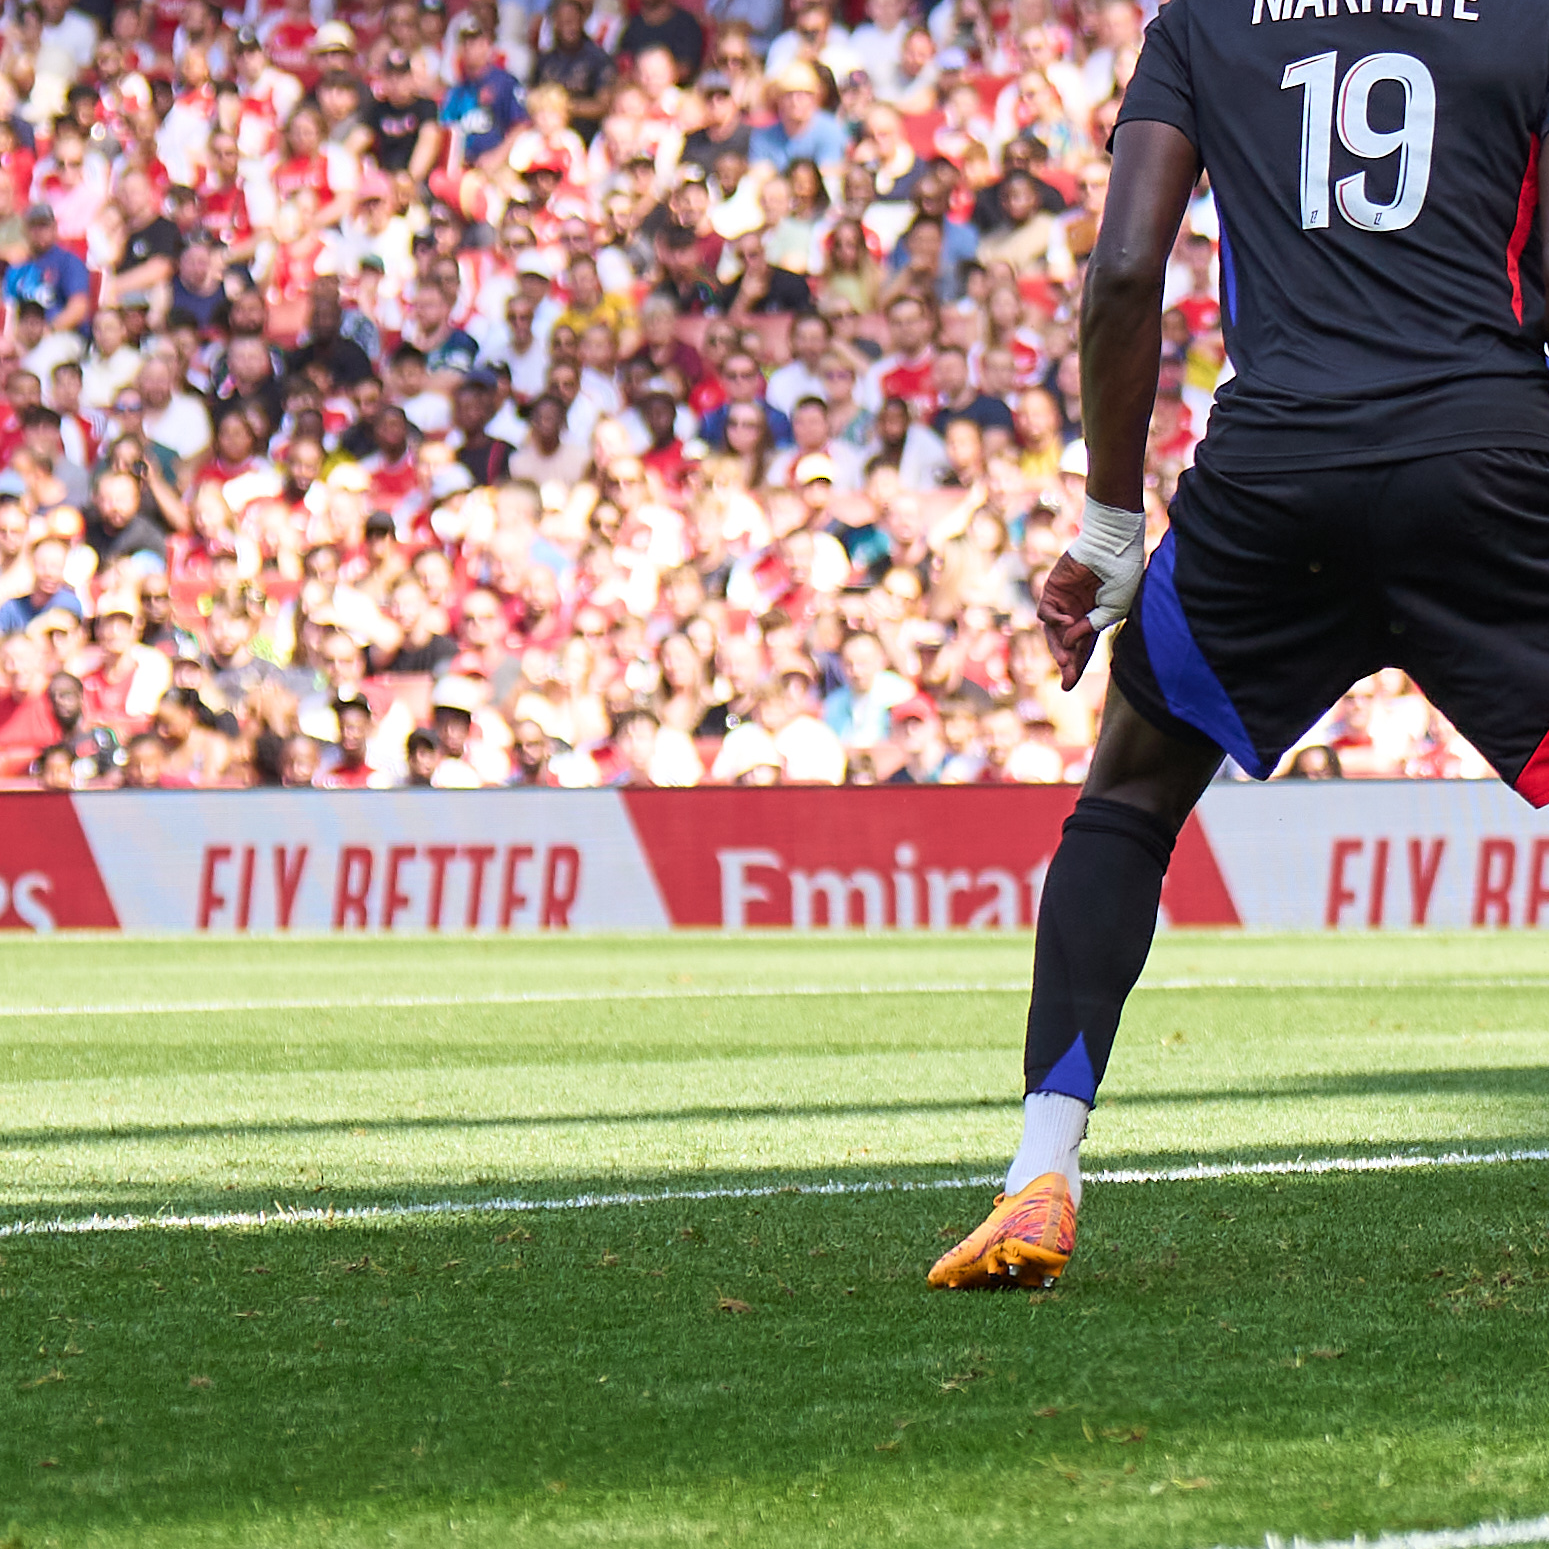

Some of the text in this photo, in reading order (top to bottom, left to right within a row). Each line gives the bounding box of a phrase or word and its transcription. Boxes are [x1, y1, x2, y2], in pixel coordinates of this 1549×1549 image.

[1281, 50, 1437, 232] 19
[196, 844, 310, 932] FLY
[331, 844, 582, 932] BETTER
[1325, 836, 1447, 929] FLY
